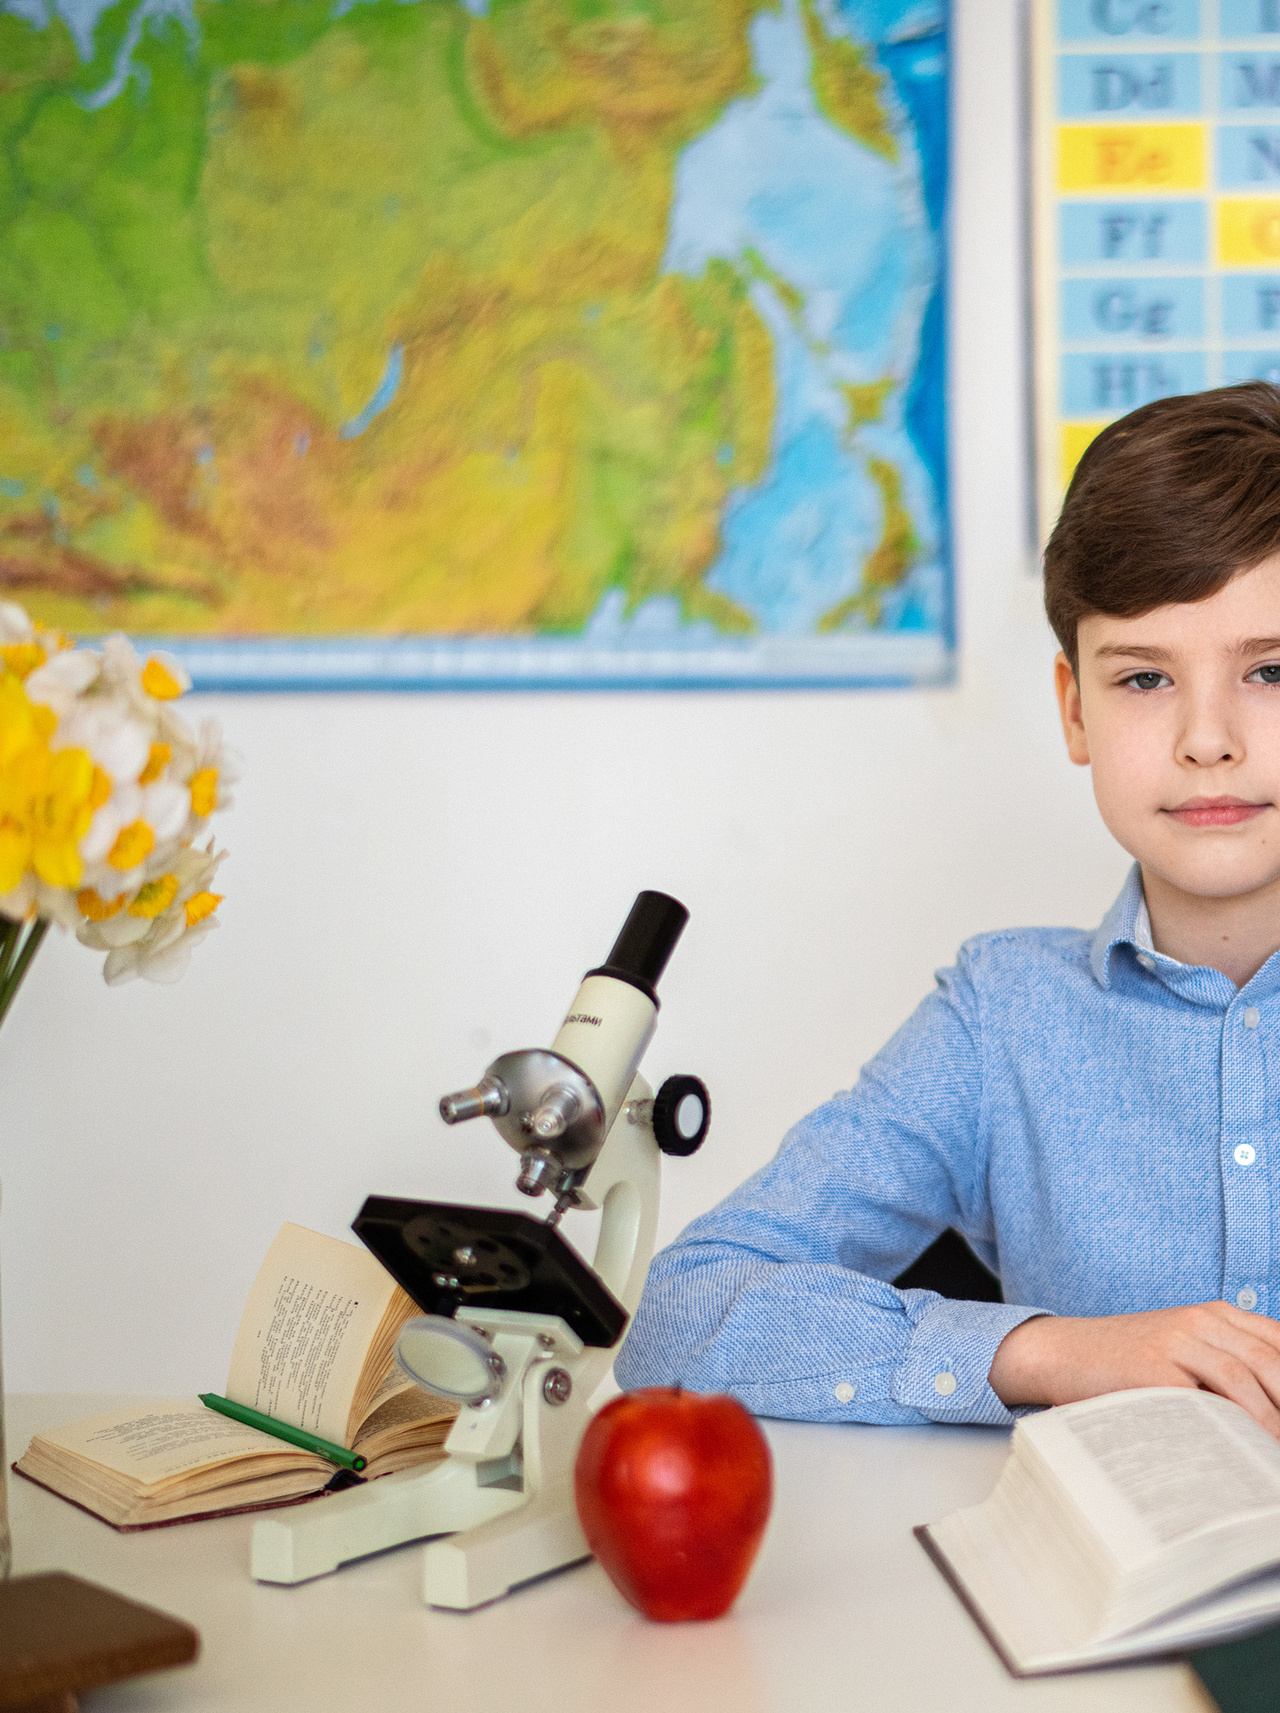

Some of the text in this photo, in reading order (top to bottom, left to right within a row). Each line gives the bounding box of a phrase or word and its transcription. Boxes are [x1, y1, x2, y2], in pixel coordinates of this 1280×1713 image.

[1091, 63, 1175, 110] Dd
[1095, 137, 1173, 184] Ee
[1099, 212, 1170, 259] Ff
[1091, 289, 1175, 338] Gg
[563, 1013, 603, 1027] льтами
